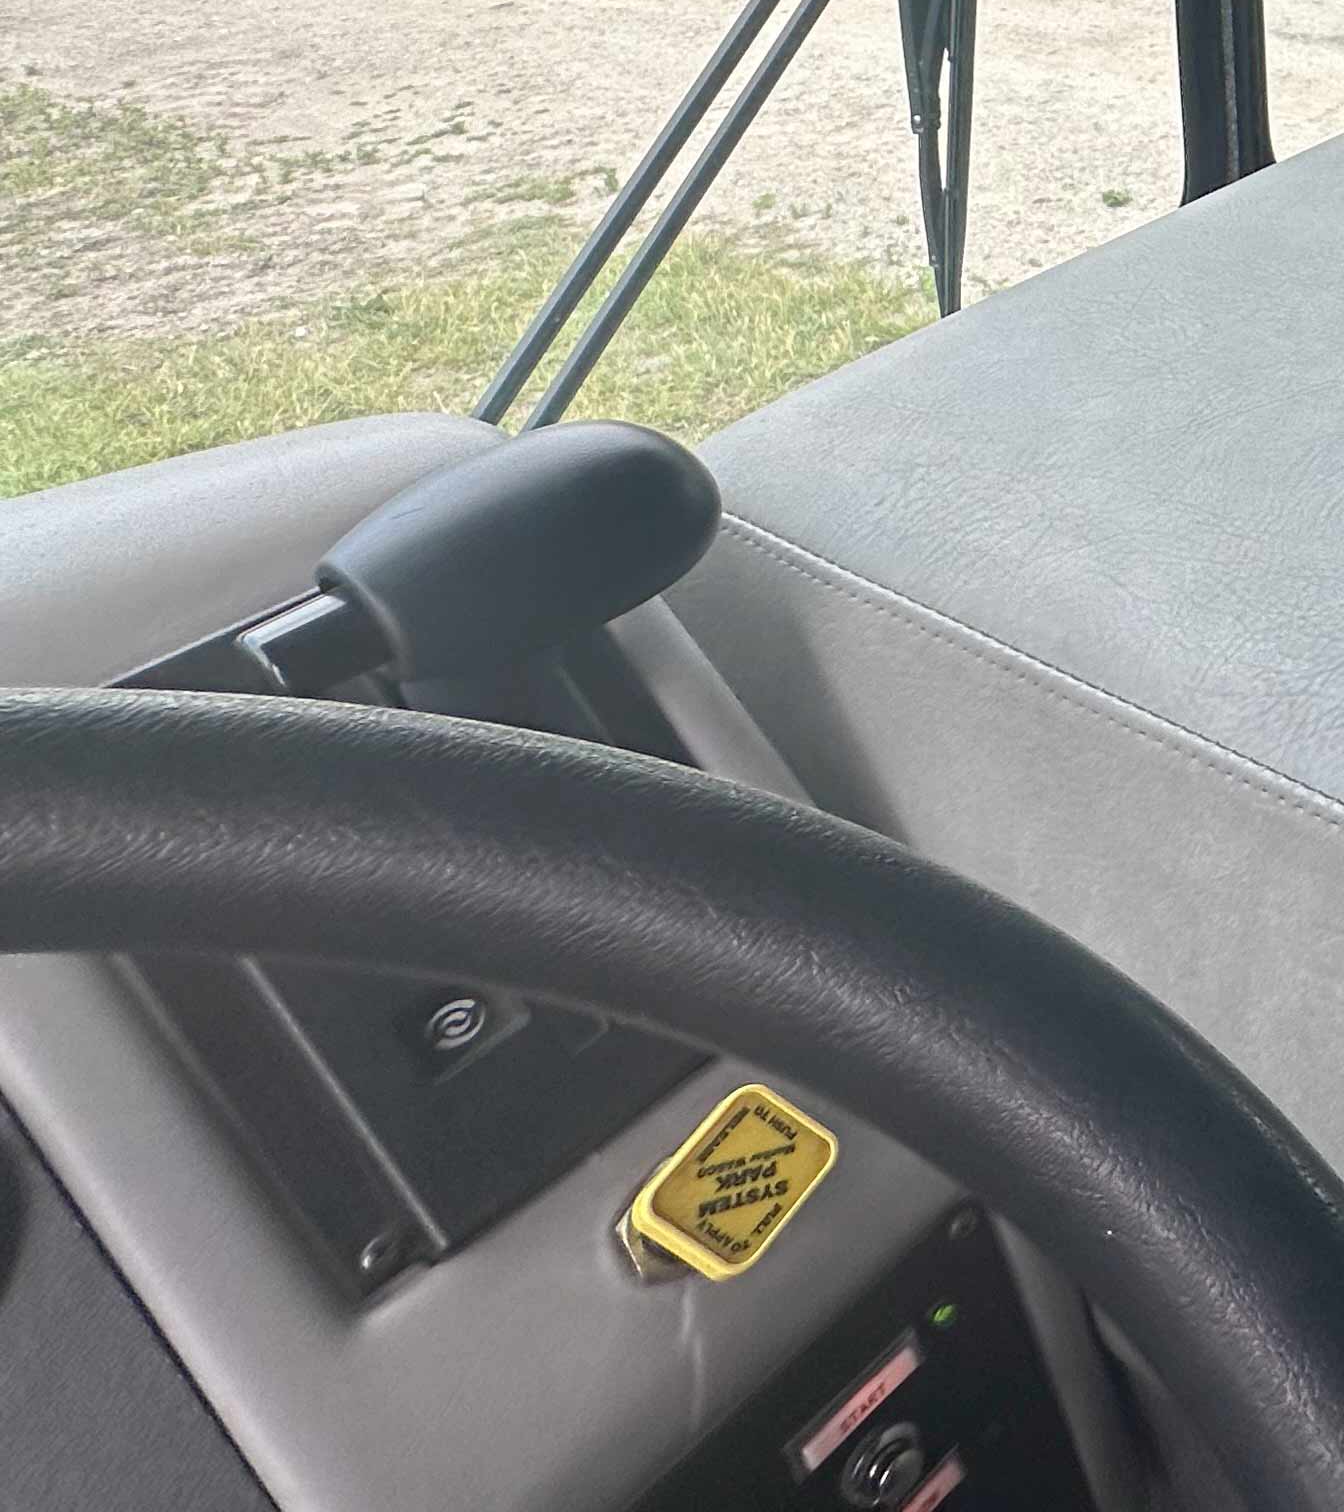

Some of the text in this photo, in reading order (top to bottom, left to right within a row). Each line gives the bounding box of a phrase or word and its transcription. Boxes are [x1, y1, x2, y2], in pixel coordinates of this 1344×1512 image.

[754, 1105, 798, 1141] PUSH TO
[714, 1159, 777, 1194] PARK
[698, 1178, 789, 1219] SYSTEM
[697, 1218, 732, 1248] APPLY
[751, 1202, 783, 1236] PULL
[840, 1381, 885, 1433] START
